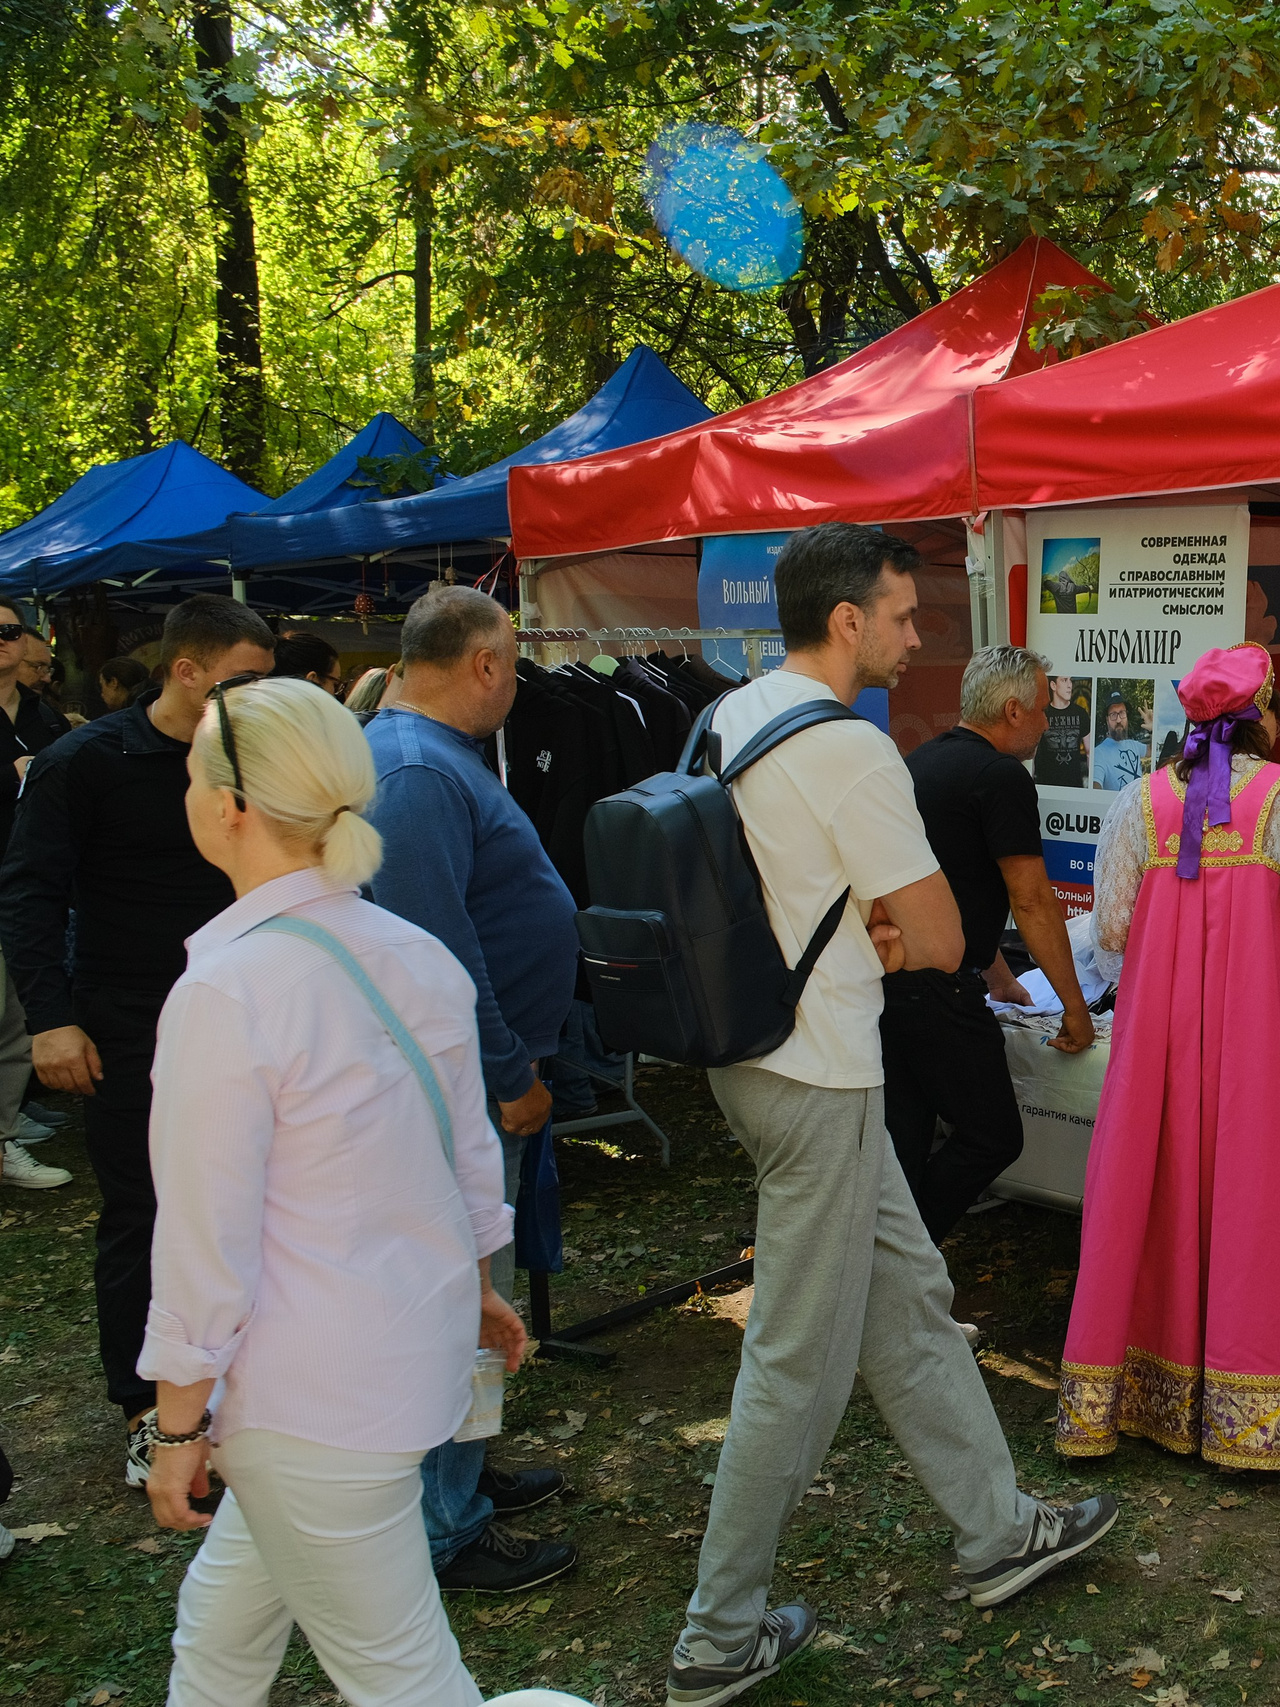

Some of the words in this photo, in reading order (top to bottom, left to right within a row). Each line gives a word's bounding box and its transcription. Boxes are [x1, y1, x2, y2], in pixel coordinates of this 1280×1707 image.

[1141, 535, 1227, 548] СОВРЕМЕННАЯ
[1172, 552, 1226, 565] ОДЕЖДА
[1119, 571, 1126, 582] С
[1127, 569, 1226, 582] ПРАВОСЛАВНЫМ
[722, 575, 770, 605] ВОЛЬНЫЙ
[1109, 587, 1117, 599] И
[1118, 587, 1225, 599] ПАТРИОТИЧЕСКИМ
[1162, 603, 1224, 616] СМЫСЛОМ
[742, 641, 787, 660] ИЕШЬ
[1074, 628, 1182, 665] ЛЮБОМИР
[1045, 811, 1104, 836] @LUB
[1070, 859, 1084, 871] ВО
[1051, 886, 1092, 903] Полный
[1021, 1104, 1067, 1123] гарантия
